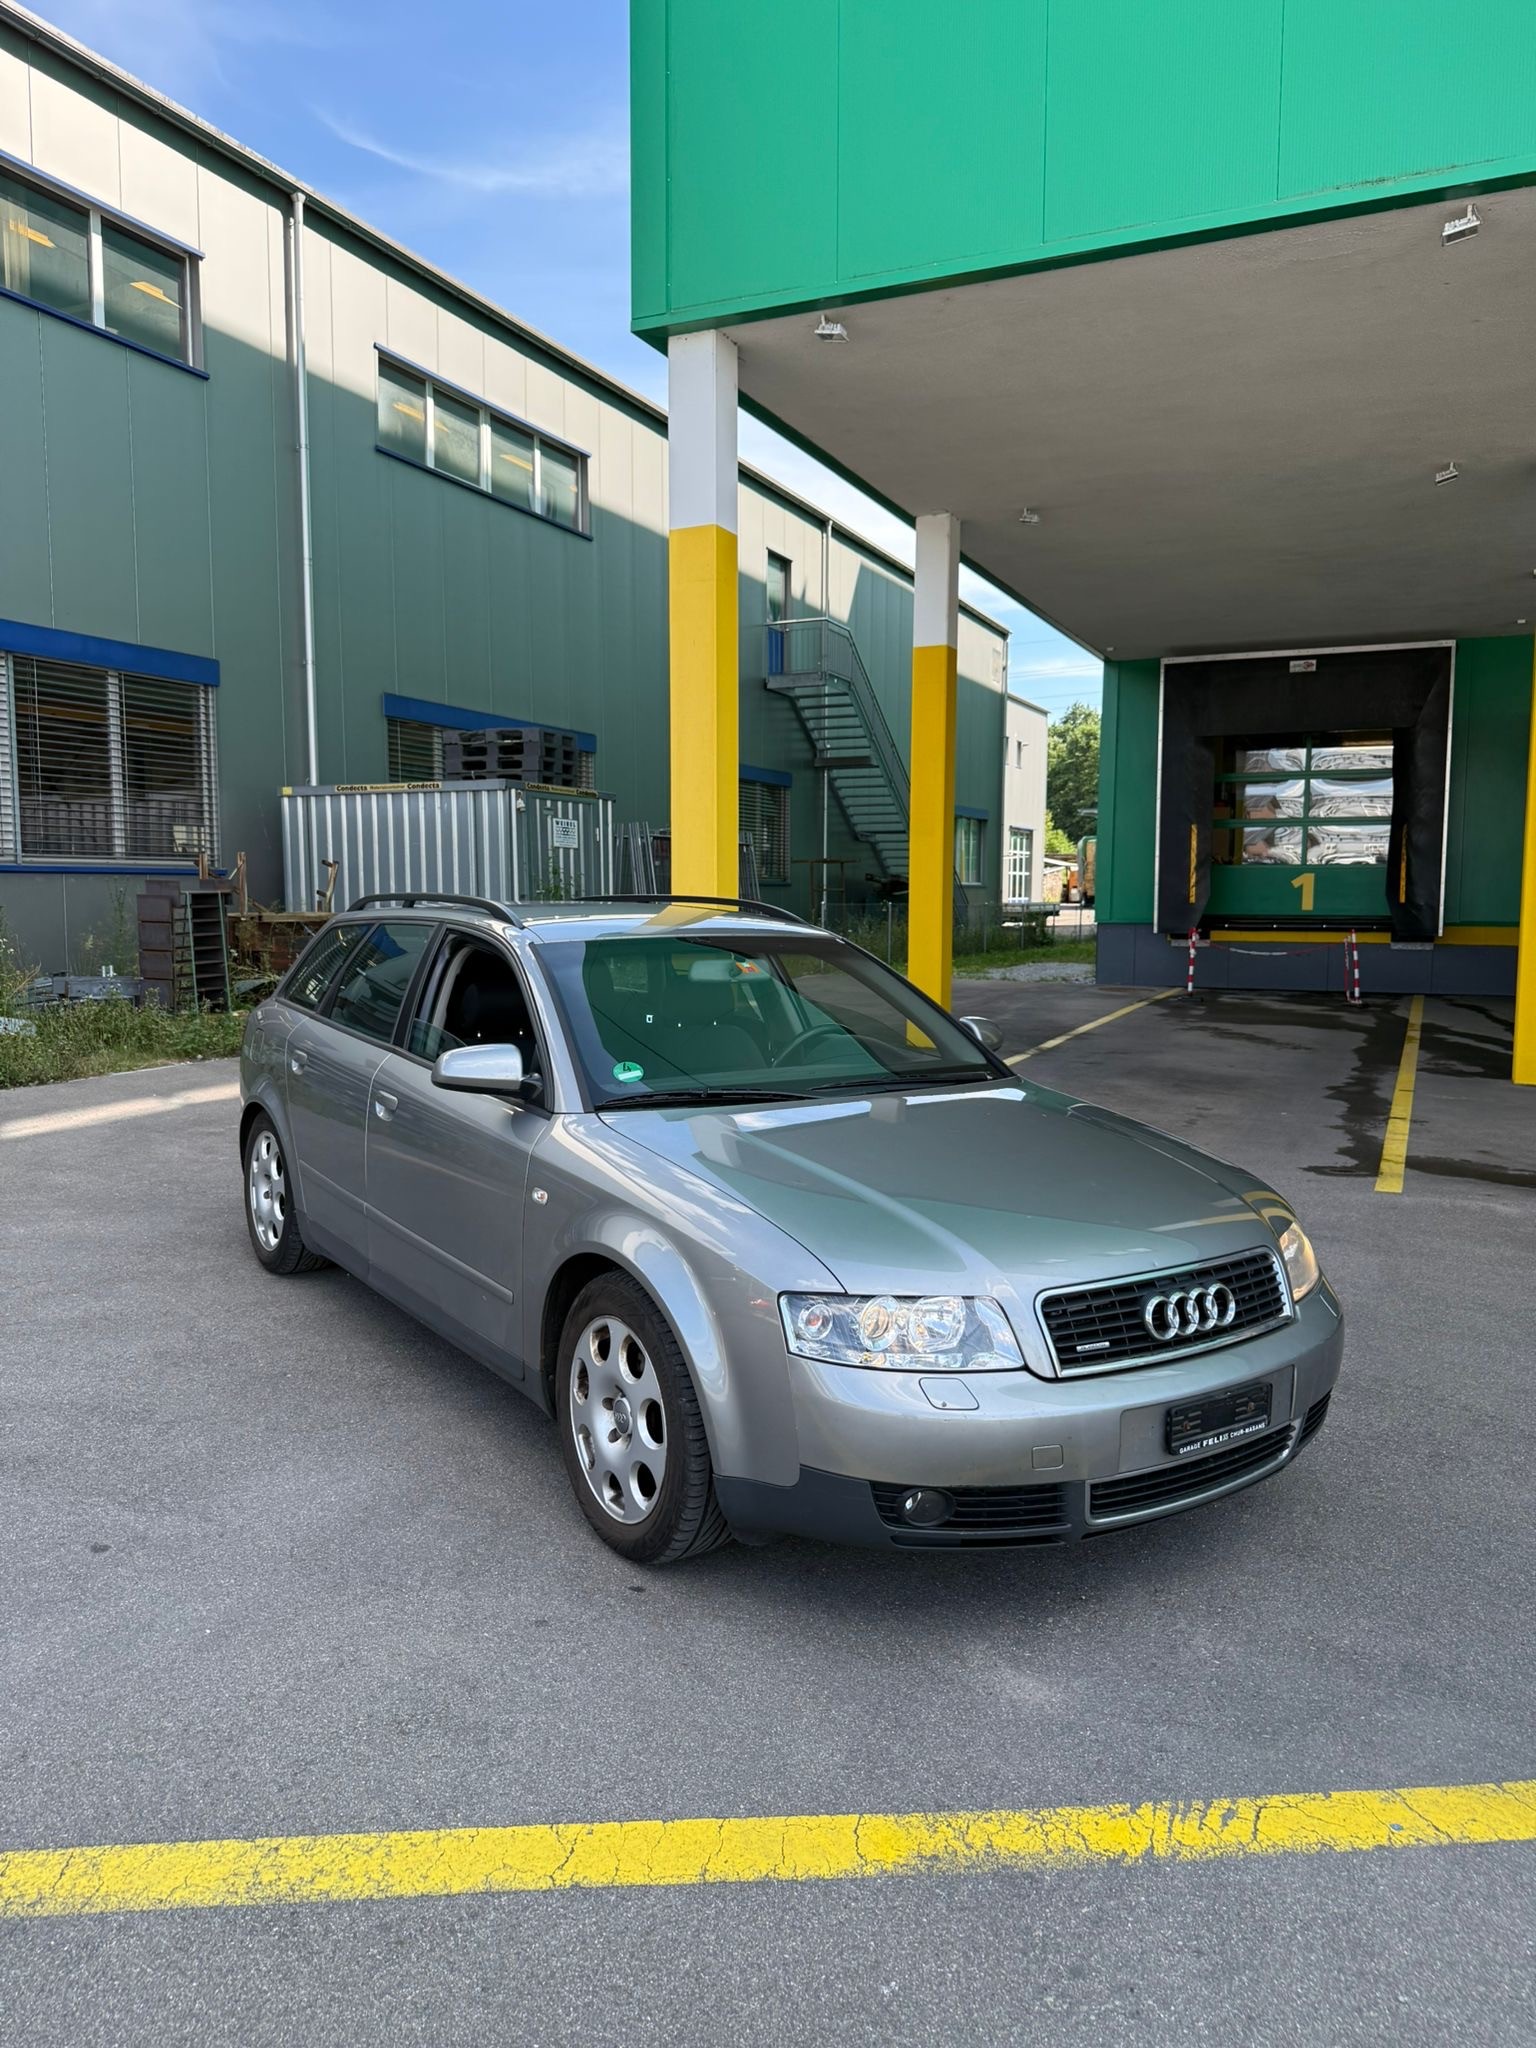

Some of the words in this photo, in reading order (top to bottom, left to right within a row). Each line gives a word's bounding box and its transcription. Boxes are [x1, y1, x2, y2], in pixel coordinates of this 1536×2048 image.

[407, 782, 440, 790] Condecta
[1290, 873, 1315, 911] 1
[1179, 1442, 1201, 1454] GARAGE
